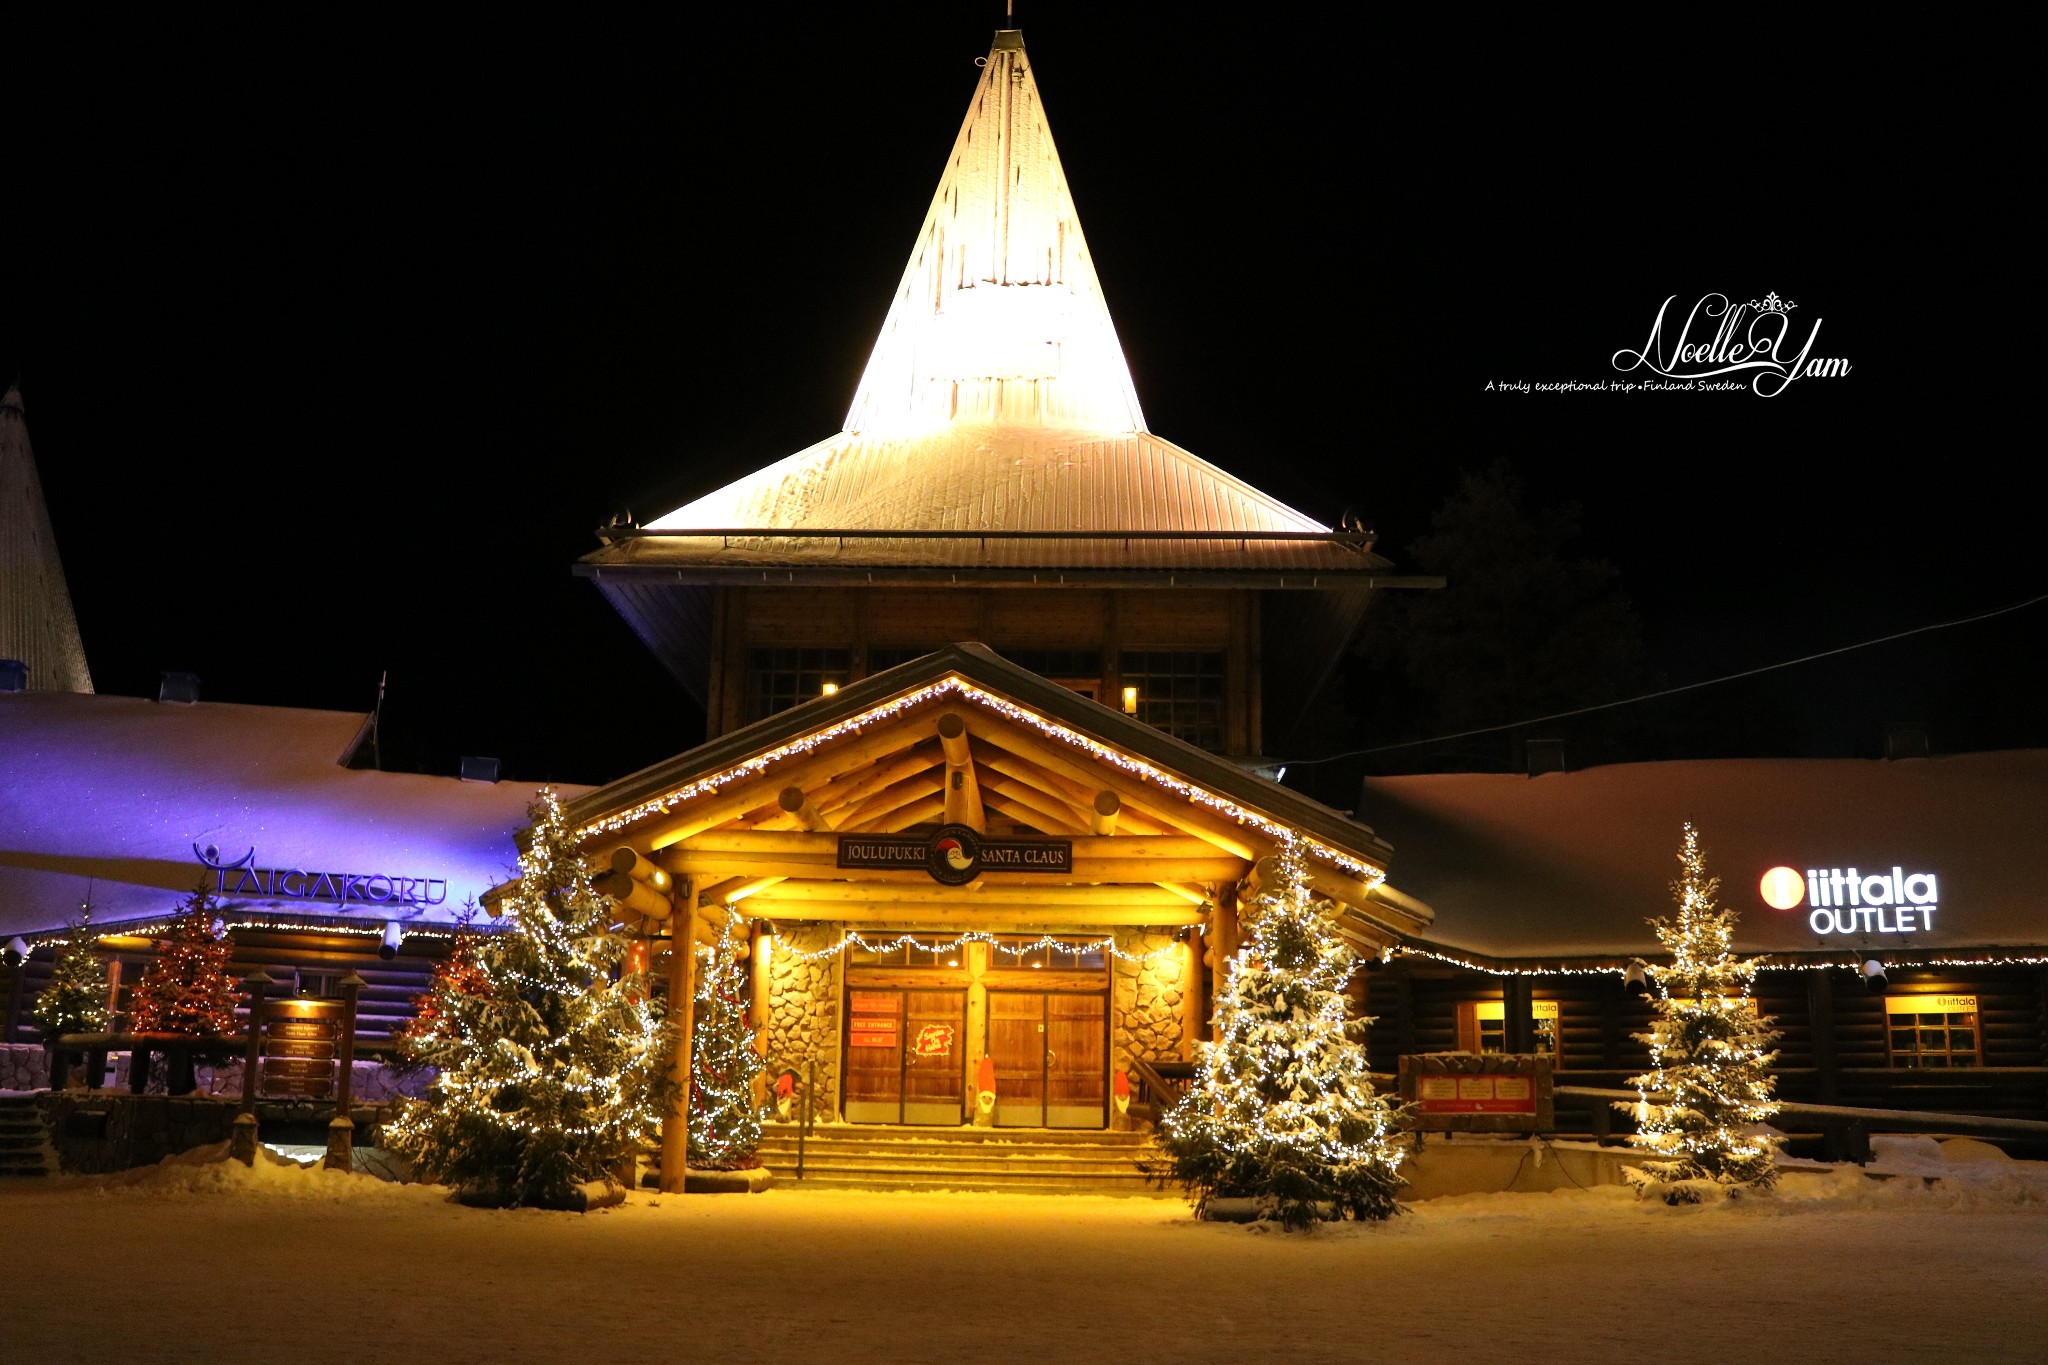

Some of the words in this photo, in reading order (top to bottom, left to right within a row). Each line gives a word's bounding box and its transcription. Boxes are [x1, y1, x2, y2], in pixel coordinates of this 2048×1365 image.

[848, 845, 926, 860] JOULUPUKKI
[981, 849, 1021, 863] SANTA
[1024, 850, 1064, 864] CLAUS
[193, 843, 448, 905] TAIGAKORU
[1807, 866, 1938, 907] iittala
[1809, 906, 1937, 935] OUTLET
[1947, 998, 1976, 1006] iittala
